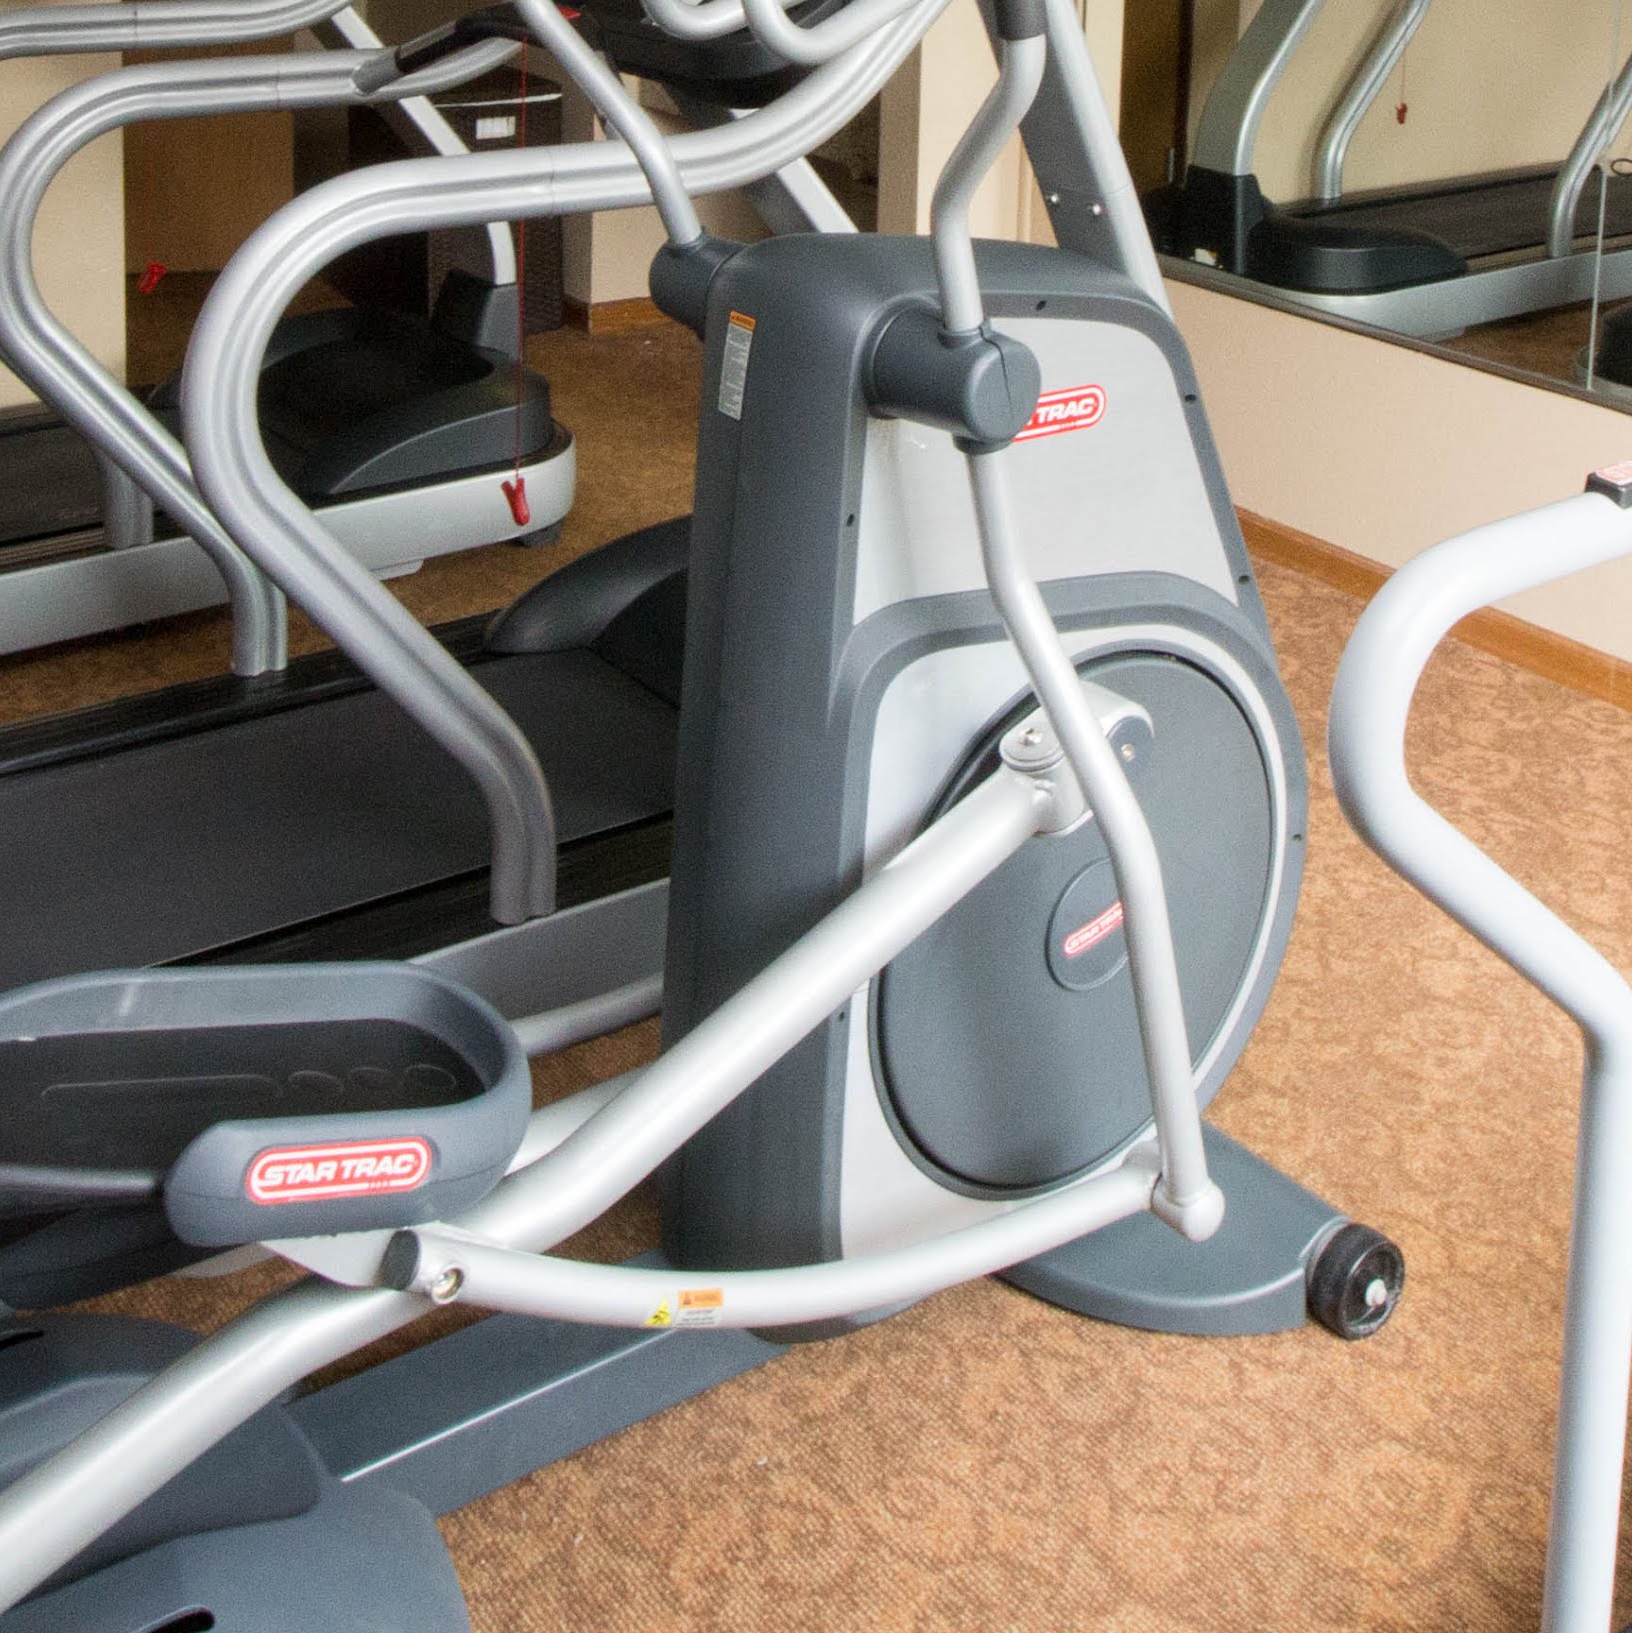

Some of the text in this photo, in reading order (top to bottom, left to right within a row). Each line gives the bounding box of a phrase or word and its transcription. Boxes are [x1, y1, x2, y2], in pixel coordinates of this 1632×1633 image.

[1037, 398, 1095, 424] TRAC
[259, 1154, 416, 1187] STAR TRAC
